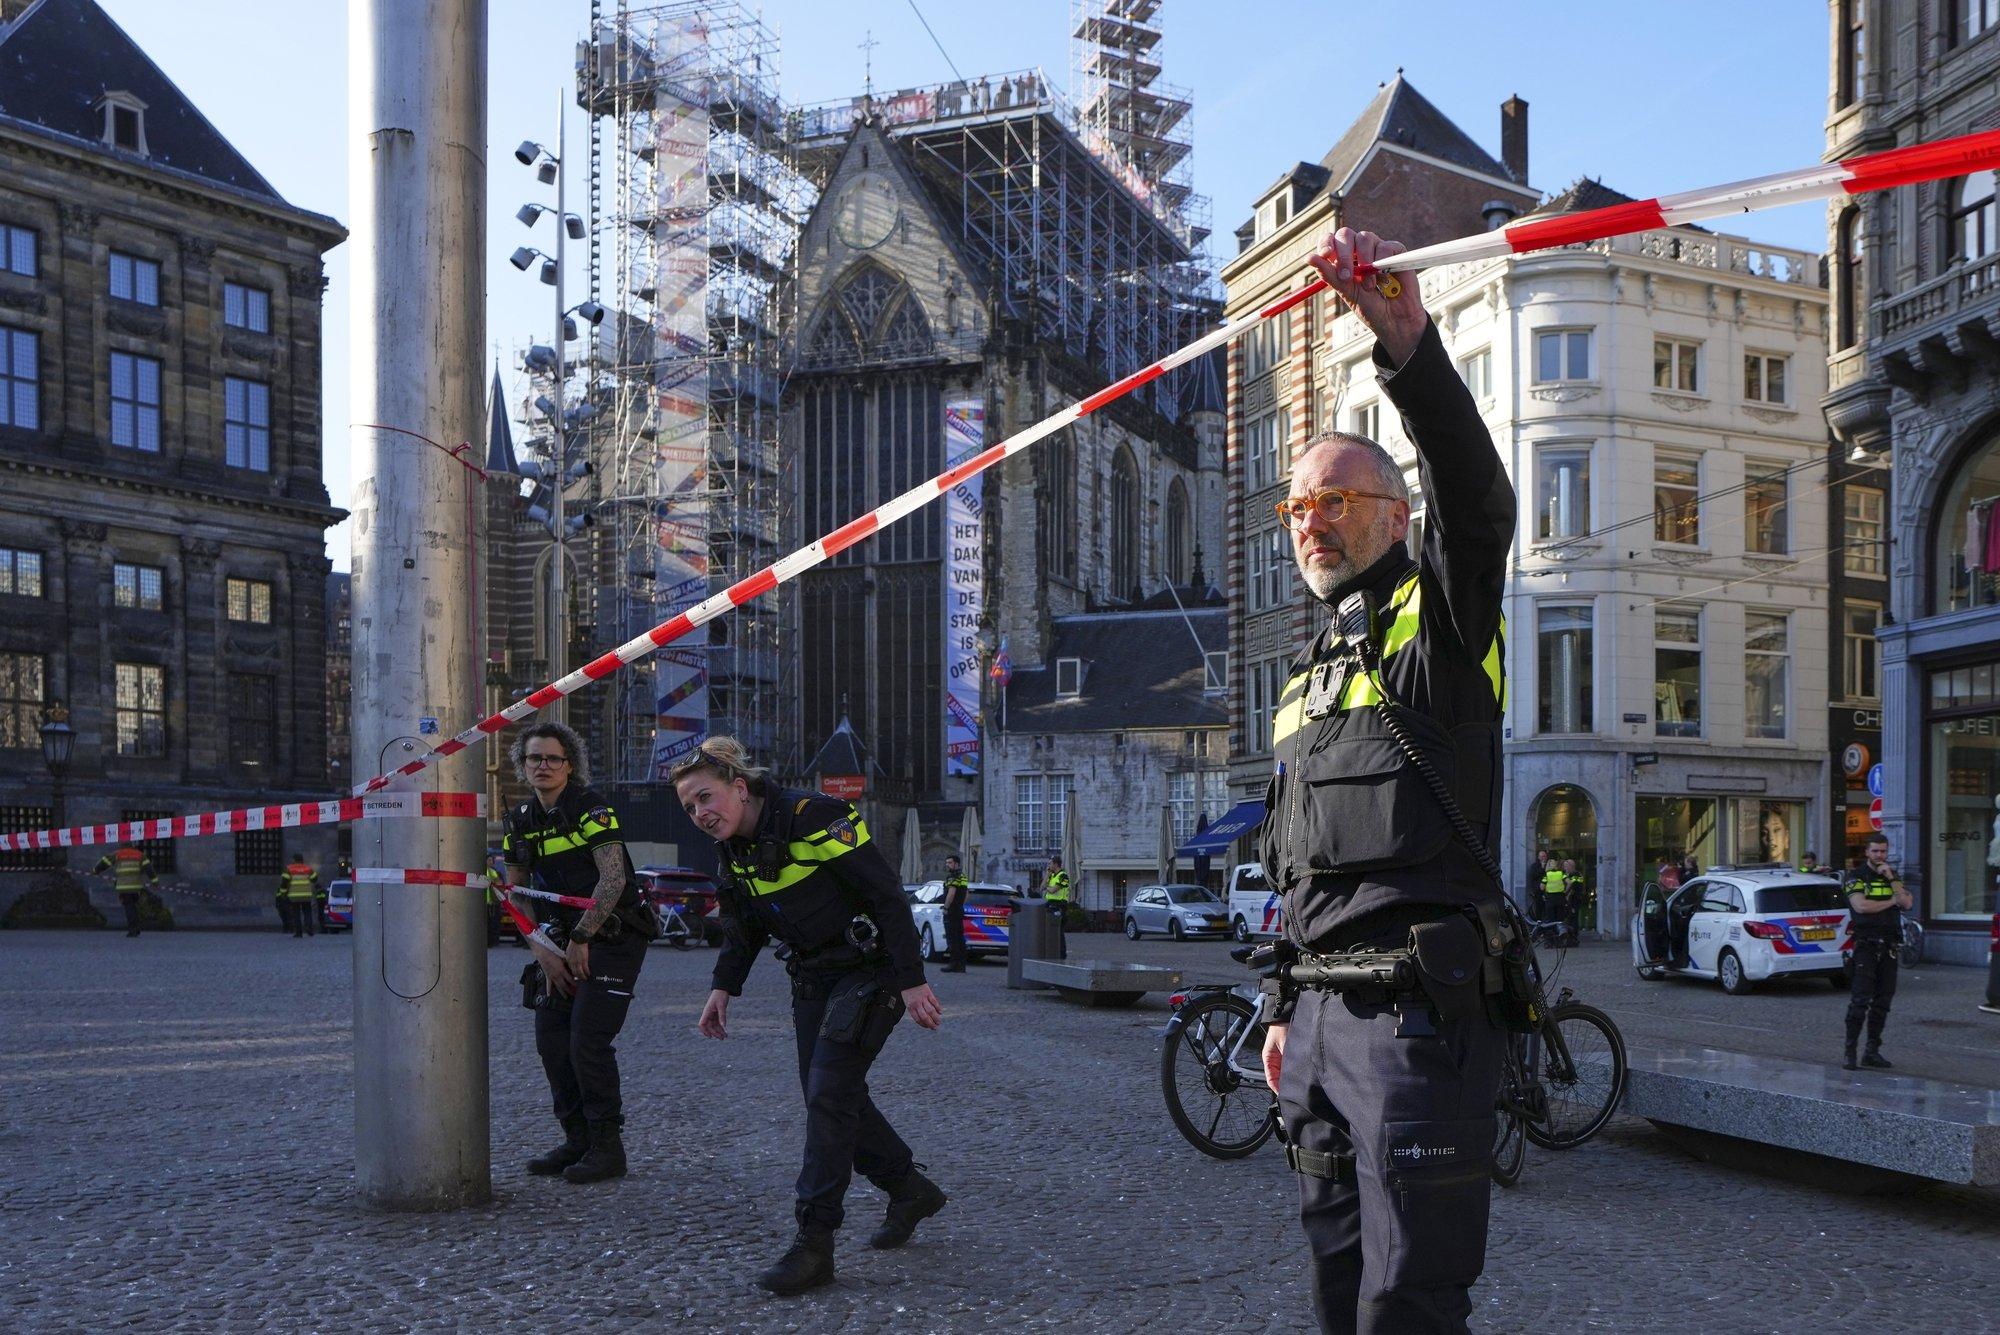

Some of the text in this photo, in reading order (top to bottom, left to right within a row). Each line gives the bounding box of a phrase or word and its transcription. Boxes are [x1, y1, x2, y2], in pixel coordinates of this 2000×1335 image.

[955, 524, 979, 539] HET
[954, 546, 980, 561] DAK
[954, 568, 980, 584] VAN
[959, 592, 976, 606] DE
[961, 636, 974, 649] IS
[367, 802, 403, 810] BETREDEN
[1405, 1142, 1448, 1159] POLITIE
